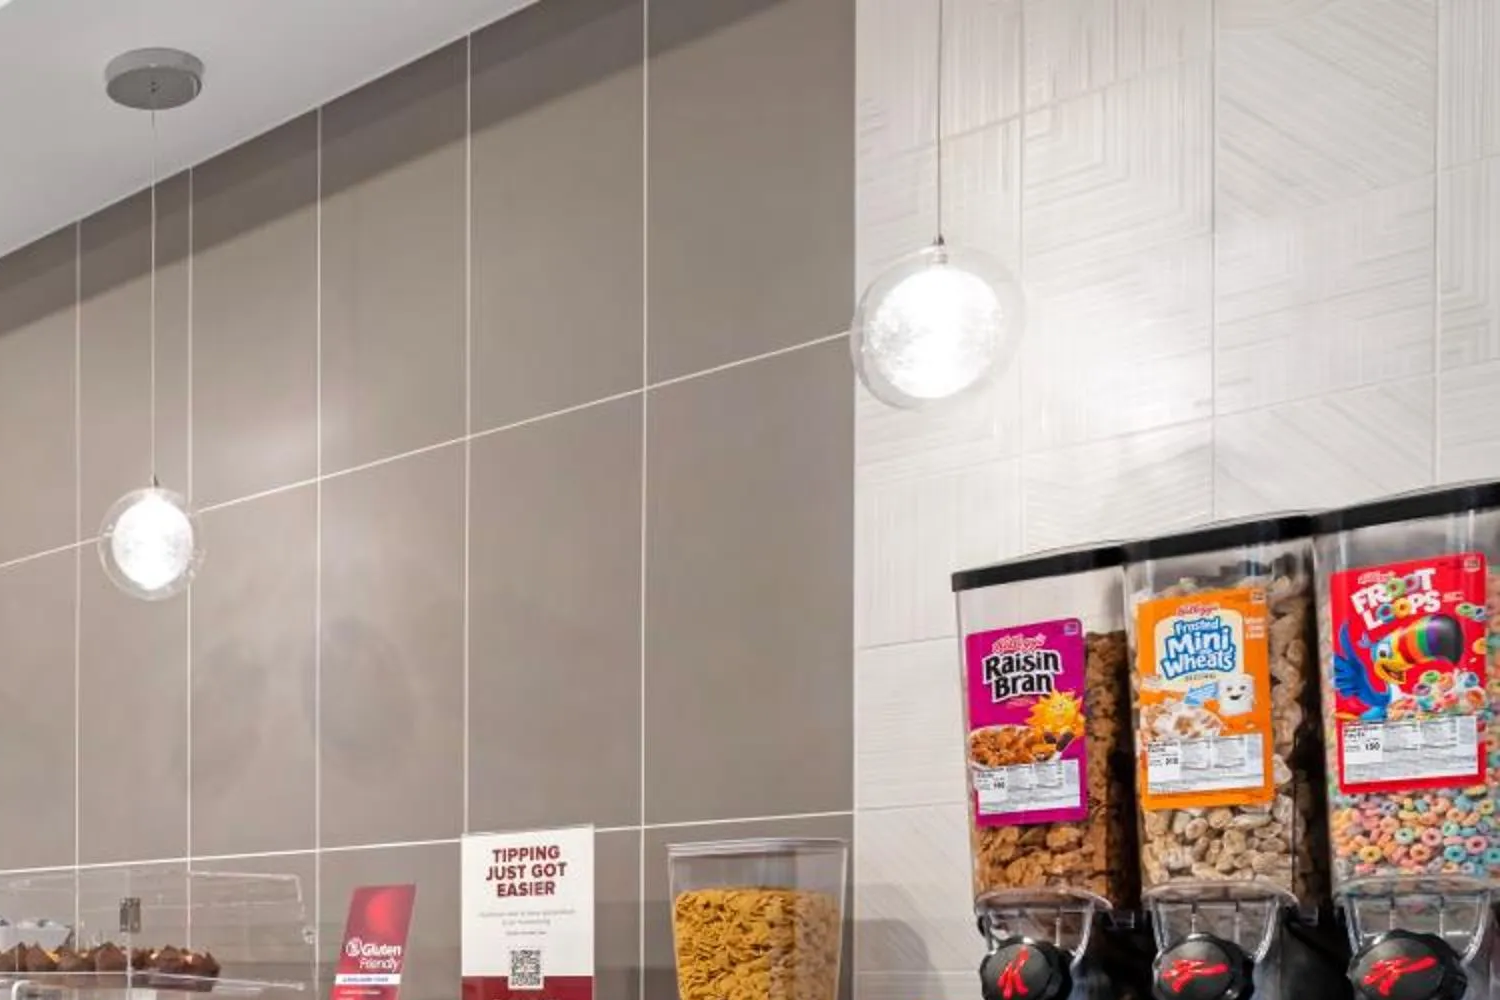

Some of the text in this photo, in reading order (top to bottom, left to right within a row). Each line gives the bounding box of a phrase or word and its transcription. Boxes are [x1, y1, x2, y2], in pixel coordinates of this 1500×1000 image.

[1351, 568, 1437, 614] FROOT
[1362, 589, 1441, 631] LOOPS
[1176, 617, 1221, 635] Frosted
[1166, 627, 1230, 660] Mini
[983, 650, 1061, 682] Raisin
[1162, 645, 1235, 679] Wheats
[994, 672, 1053, 700] Bran
[492, 845, 561, 863] TIPPING
[486, 862, 568, 881] JUST GOT
[497, 881, 556, 898] EASIER
[362, 944, 402, 957] Gluten
[359, 956, 399, 973] Friendly
